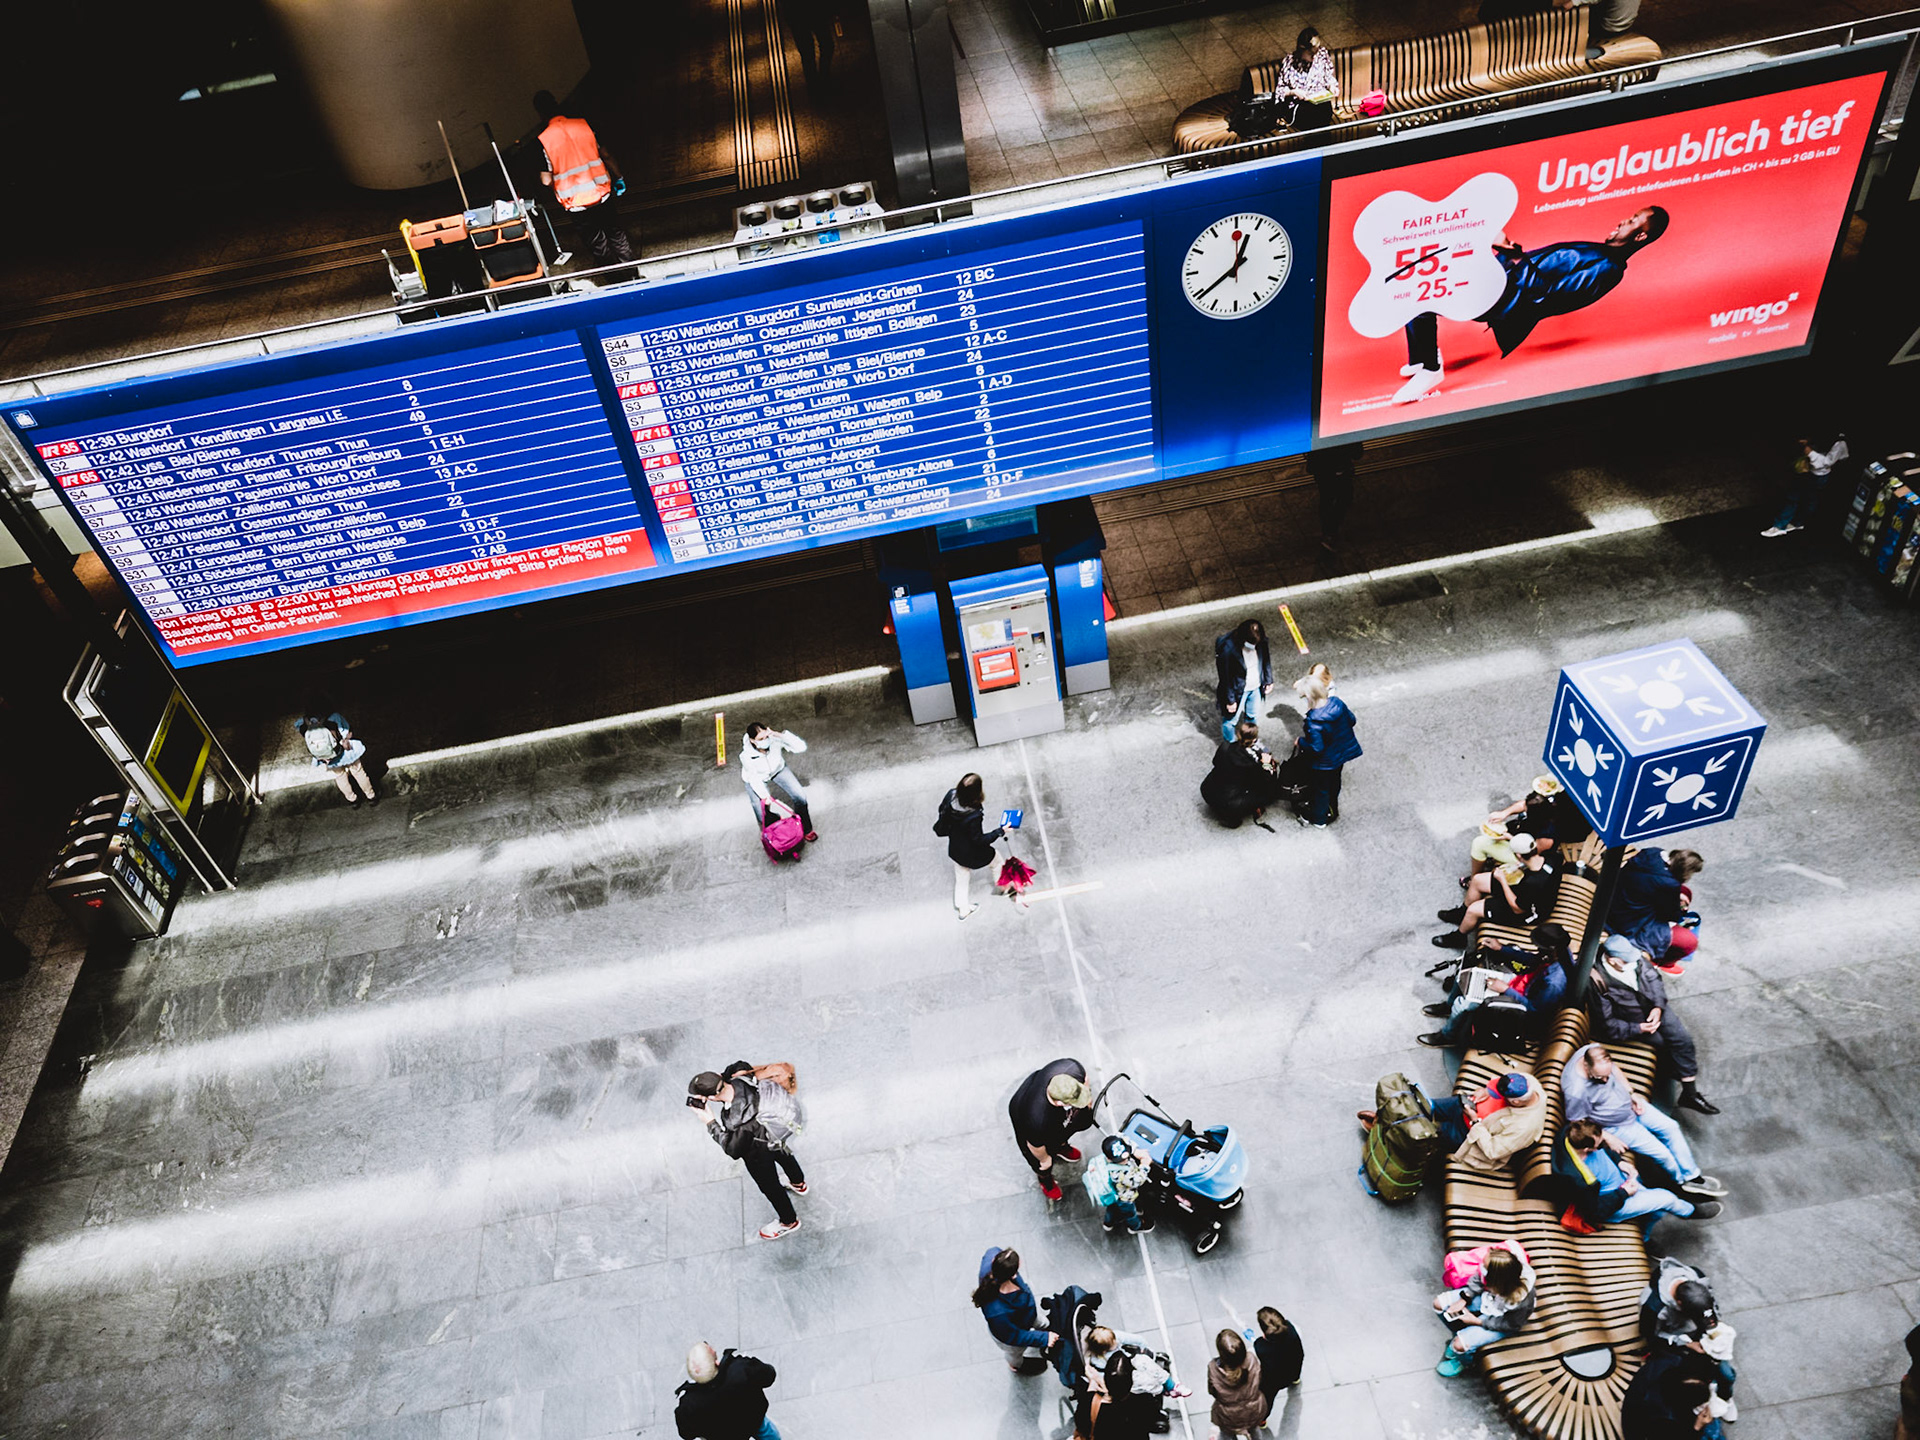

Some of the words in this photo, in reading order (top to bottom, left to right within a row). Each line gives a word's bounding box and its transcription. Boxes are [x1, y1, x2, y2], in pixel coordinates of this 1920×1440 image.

[1533, 197, 1586, 213] Lebenslang
[1587, 186, 1635, 203] unlimitiert
[1636, 176, 1691, 193] telefonieren
[1692, 173, 1700, 182] &
[1701, 168, 1730, 180] surfen
[1731, 166, 1741, 174] in
[1742, 162, 1757, 172] CH
[1764, 158, 1779, 168] bis
[1780, 157, 1791, 165] zu
[1792, 153, 1799, 162] 2
[1799, 150, 1814, 160] GB
[1815, 149, 1825, 158] in
[1826, 145, 1840, 155] EU
[1537, 118, 1770, 193] Unglaublich
[1779, 100, 1855, 145] tief
[1382, 228, 1435, 244] Schweizweit
[1438, 219, 1484, 234] unlimitiert
[1403, 215, 1432, 229] FAIR
[1436, 208, 1468, 223] FLAT
[604, 339, 629, 352] S44
[642, 329, 678, 345] 12:50
[678, 316, 738, 338] Wankdorf
[744, 305, 801, 328] Burgdorf
[805, 283, 922, 314] Sumiswald-Grünen
[955, 271, 971, 285] 12
[974, 267, 995, 281] BC
[609, 355, 627, 367] S8
[647, 344, 683, 360] 12:52
[682, 333, 754, 354] Worblaufen
[759, 315, 846, 339] Oberzollikofen
[852, 298, 918, 324] Jegenstorf
[957, 288, 974, 301] 24
[615, 371, 630, 382] S7
[652, 360, 687, 376] 12:53
[687, 348, 758, 369] Worblaufen
[762, 332, 840, 357] Papiermühle
[844, 324, 883, 341] Ittigen
[888, 313, 938, 333] Bolligen
[959, 303, 976, 317] 23
[1710, 300, 1788, 327] wingo
[625, 401, 641, 412] S3
[661, 390, 696, 405] 13:00
[696, 378, 754, 399] Wankdorf
[760, 368, 818, 387] Zollikofen
[822, 362, 852, 376] Lyss
[856, 347, 926, 370] Biel/Bienne
[964, 334, 980, 347] 12
[982, 329, 1007, 344] A-C
[630, 415, 644, 426] S7
[666, 404, 700, 420] 13:00
[700, 393, 769, 413] Worblaufen
[774, 377, 849, 401] Papiermühle
[852, 369, 886, 384] Worb
[888, 362, 914, 377] Dorf
[966, 349, 982, 362] 24
[639, 382, 656, 394] 66
[657, 375, 692, 390] 12:53
[692, 368, 739, 384] Kerzers
[744, 363, 764, 374] Ins
[768, 348, 829, 370] Neuchâtel
[969, 319, 978, 331] 5
[50, 460, 69, 472] S2
[88, 450, 126, 465] 12:42
[124, 438, 187, 458] Wankdorf
[190, 426, 268, 449] Konolfingen
[269, 414, 327, 434] Langnau
[325, 408, 348, 422] i.E.
[408, 395, 420, 406] 2
[60, 442, 79, 453] 35
[78, 435, 116, 450] 12:38
[115, 424, 176, 446] Burgdorf
[402, 379, 412, 391] 8
[79, 471, 98, 482] 65
[97, 464, 135, 479] 12:42
[133, 460, 168, 475] Lyss
[168, 446, 243, 469] Biel/Bienne
[409, 410, 426, 422] 49
[69, 490, 87, 500] S4
[107, 479, 144, 494] 12:42
[142, 474, 177, 490] Belp
[176, 467, 218, 480] Toffen
[221, 453, 276, 472] Kaufdorf
[334, 438, 369, 451] Thun
[422, 424, 432, 435] 5
[79, 504, 96, 514] S1
[116, 492, 153, 507] 12:45
[151, 478, 243, 503] Niederwangen
[244, 468, 292, 484] Flamatt
[295, 448, 402, 476] Fribourg/Freiburg
[429, 439, 437, 449] 1
[439, 434, 465, 448] E-H
[88, 517, 104, 527] S7
[125, 506, 161, 521] 12:45
[160, 495, 231, 514] Worblaufen
[234, 480, 313, 503] Papiermühle
[313, 472, 349, 486] Worb
[348, 466, 377, 480] Dorf
[427, 453, 445, 465] 24
[97, 530, 121, 541] S31
[134, 520, 170, 534] 12:46
[168, 509, 228, 528] Wankdorf
[231, 499, 291, 517] Zollikofen
[294, 479, 401, 505] Münchenbuchsee
[434, 467, 451, 479] 13
[454, 462, 478, 476] A-C
[153, 619, 179, 629] Von
[178, 612, 221, 625] Freitag
[220, 604, 257, 617] 06.08.
[258, 601, 274, 611] ab
[274, 594, 308, 607] 22:00
[308, 591, 330, 601] Uhr
[331, 586, 351, 597] bis
[351, 579, 396, 593] Montag
[396, 570, 433, 584] 09.08.
[433, 564, 466, 577] 05:00
[467, 560, 488, 571] Uhr
[490, 554, 527, 567] finden
[527, 551, 540, 560] in
[540, 547, 560, 557] der
[561, 539, 602, 553] Region
[603, 534, 631, 545] Bern
[161, 620, 230, 639] Bauarbeiten
[231, 614, 261, 626] statt.
[261, 611, 278, 620] Es
[277, 603, 319, 617] kommt
[319, 601, 335, 610] zu
[334, 586, 399, 607] zahlreichen
[399, 567, 517, 595] Fahrplanänderungen.
[517, 561, 545, 572] Bitte
[546, 554, 583, 568] prüfen
[583, 549, 603, 559] Sie
[604, 545, 627, 556] Ihre
[166, 630, 233, 648] Verbindung
[232, 627, 249, 636] im
[249, 611, 341, 633] Online-Fahrplan.
